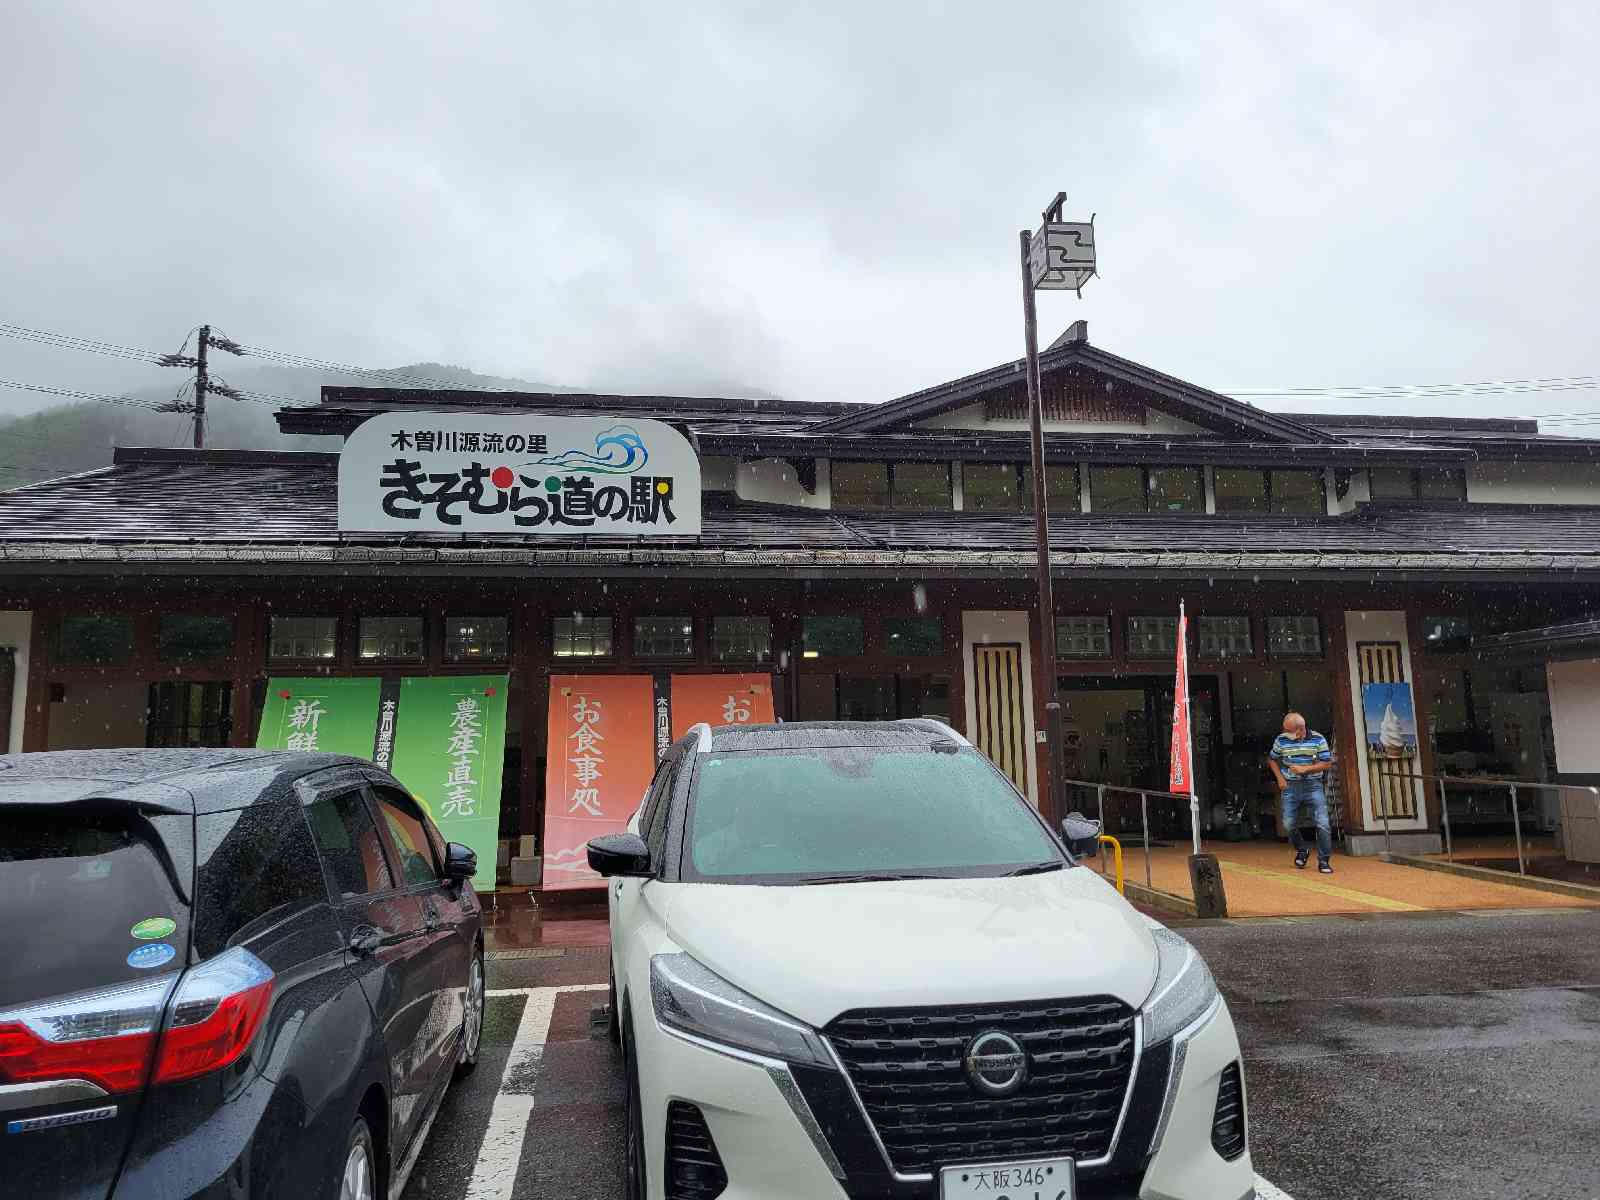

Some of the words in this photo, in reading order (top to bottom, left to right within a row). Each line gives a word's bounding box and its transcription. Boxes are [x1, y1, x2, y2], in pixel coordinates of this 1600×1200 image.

[391, 430, 548, 454] 木曽川源流の里
[380, 458, 677, 527] きそむら道の駅
[441, 697, 483, 818] 農産直売
[568, 695, 605, 816] お食事処
[656, 696, 670, 763] 木曽川源流の
[24, 1110, 111, 1129] HYBRID
